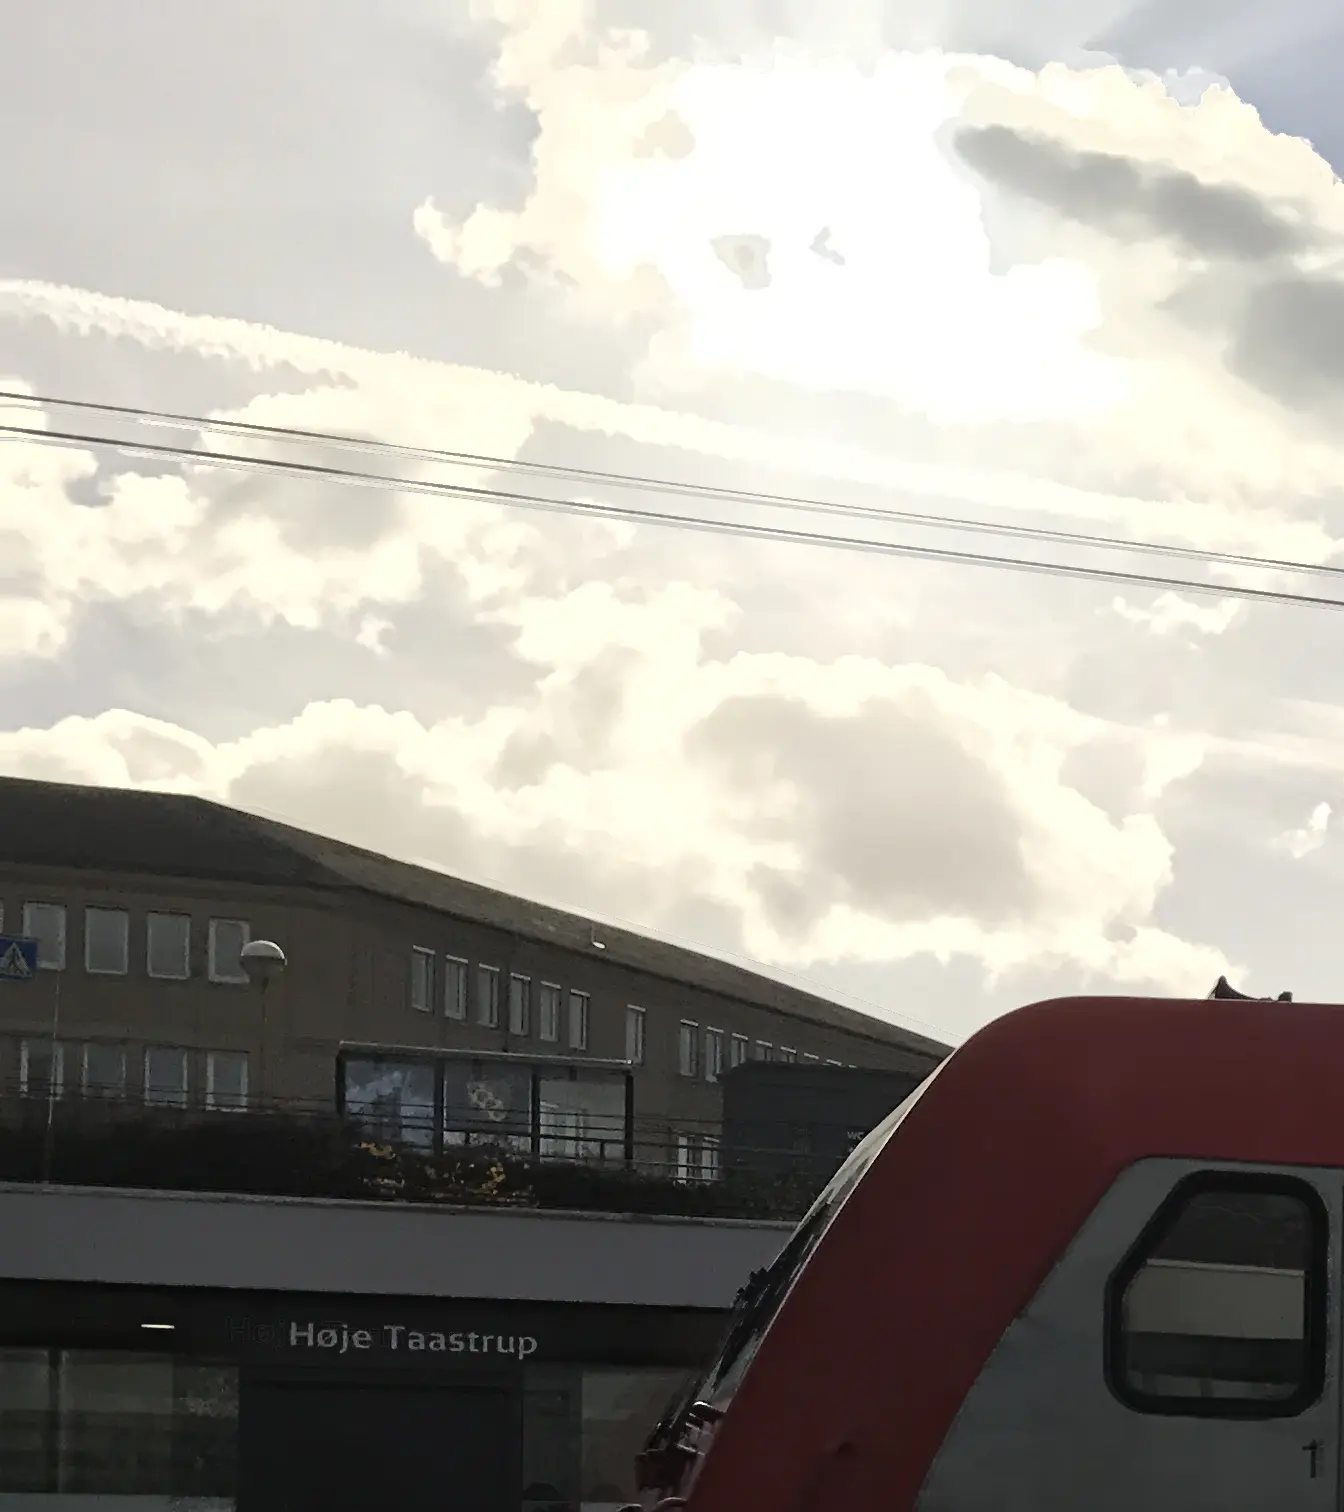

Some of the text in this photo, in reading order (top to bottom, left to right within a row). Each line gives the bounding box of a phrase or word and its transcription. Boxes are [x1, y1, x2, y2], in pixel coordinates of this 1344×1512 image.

[289, 1321, 539, 1360] Høje Taastrup
[1302, 1440, 1318, 1478] 1
